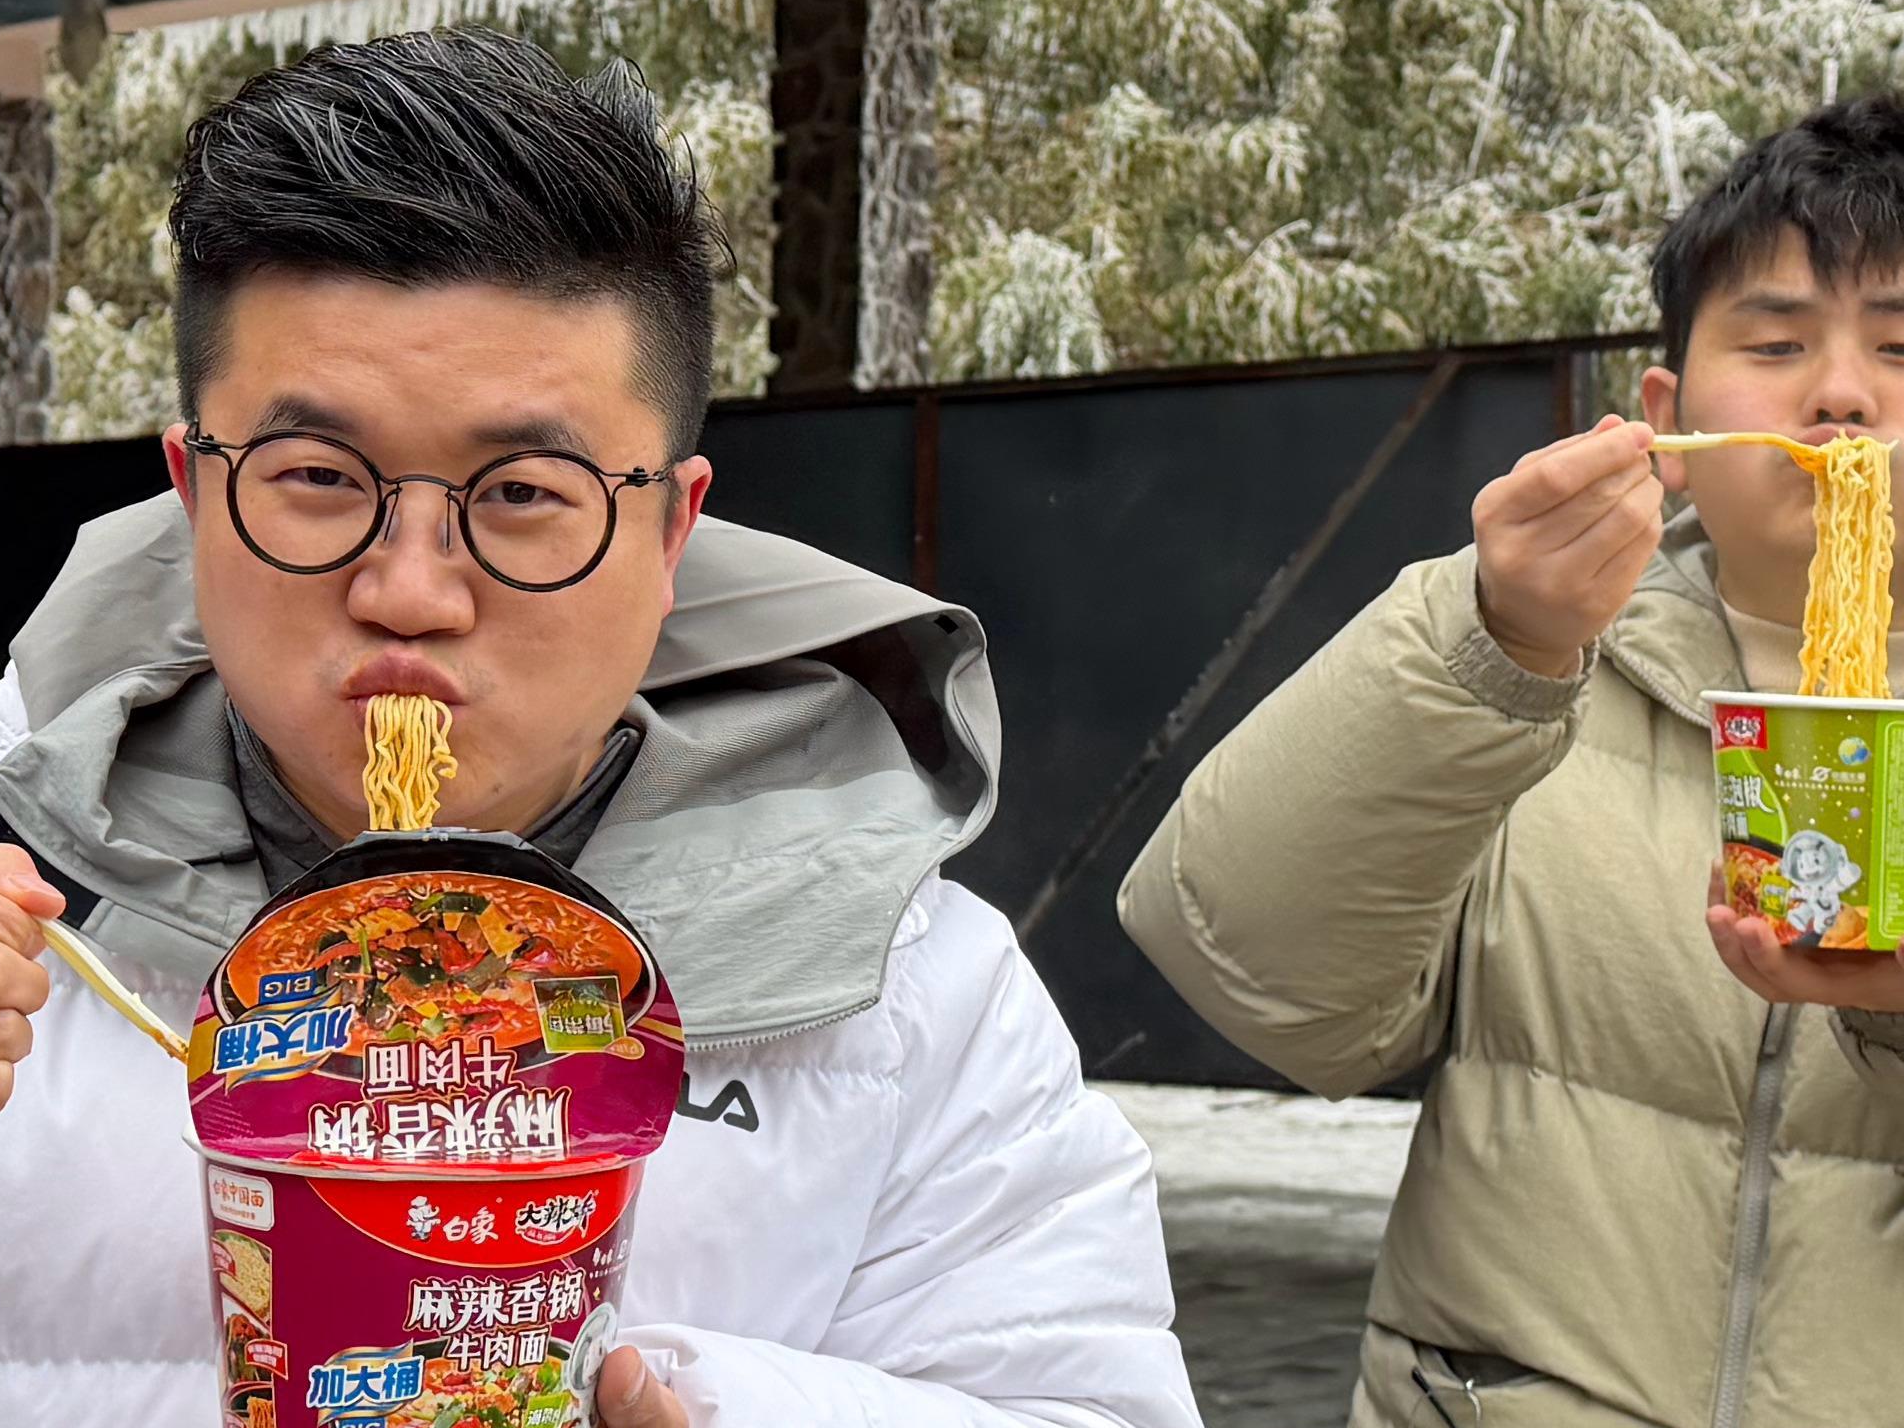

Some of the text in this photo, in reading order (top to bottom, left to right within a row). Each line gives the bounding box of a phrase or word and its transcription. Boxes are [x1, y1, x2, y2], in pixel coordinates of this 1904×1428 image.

[263, 974, 312, 999] BIG
[215, 1004, 352, 1073] 加大桶
[364, 1040, 512, 1098] 牛肉面
[310, 1087, 567, 1161] 麻辣香锅
[673, 1071, 760, 1133] LA
[442, 1207, 499, 1245] 白象
[409, 1270, 585, 1333] 麻辣香锅
[447, 1331, 549, 1372] 牛肉面
[306, 1352, 423, 1410] 加大桶
